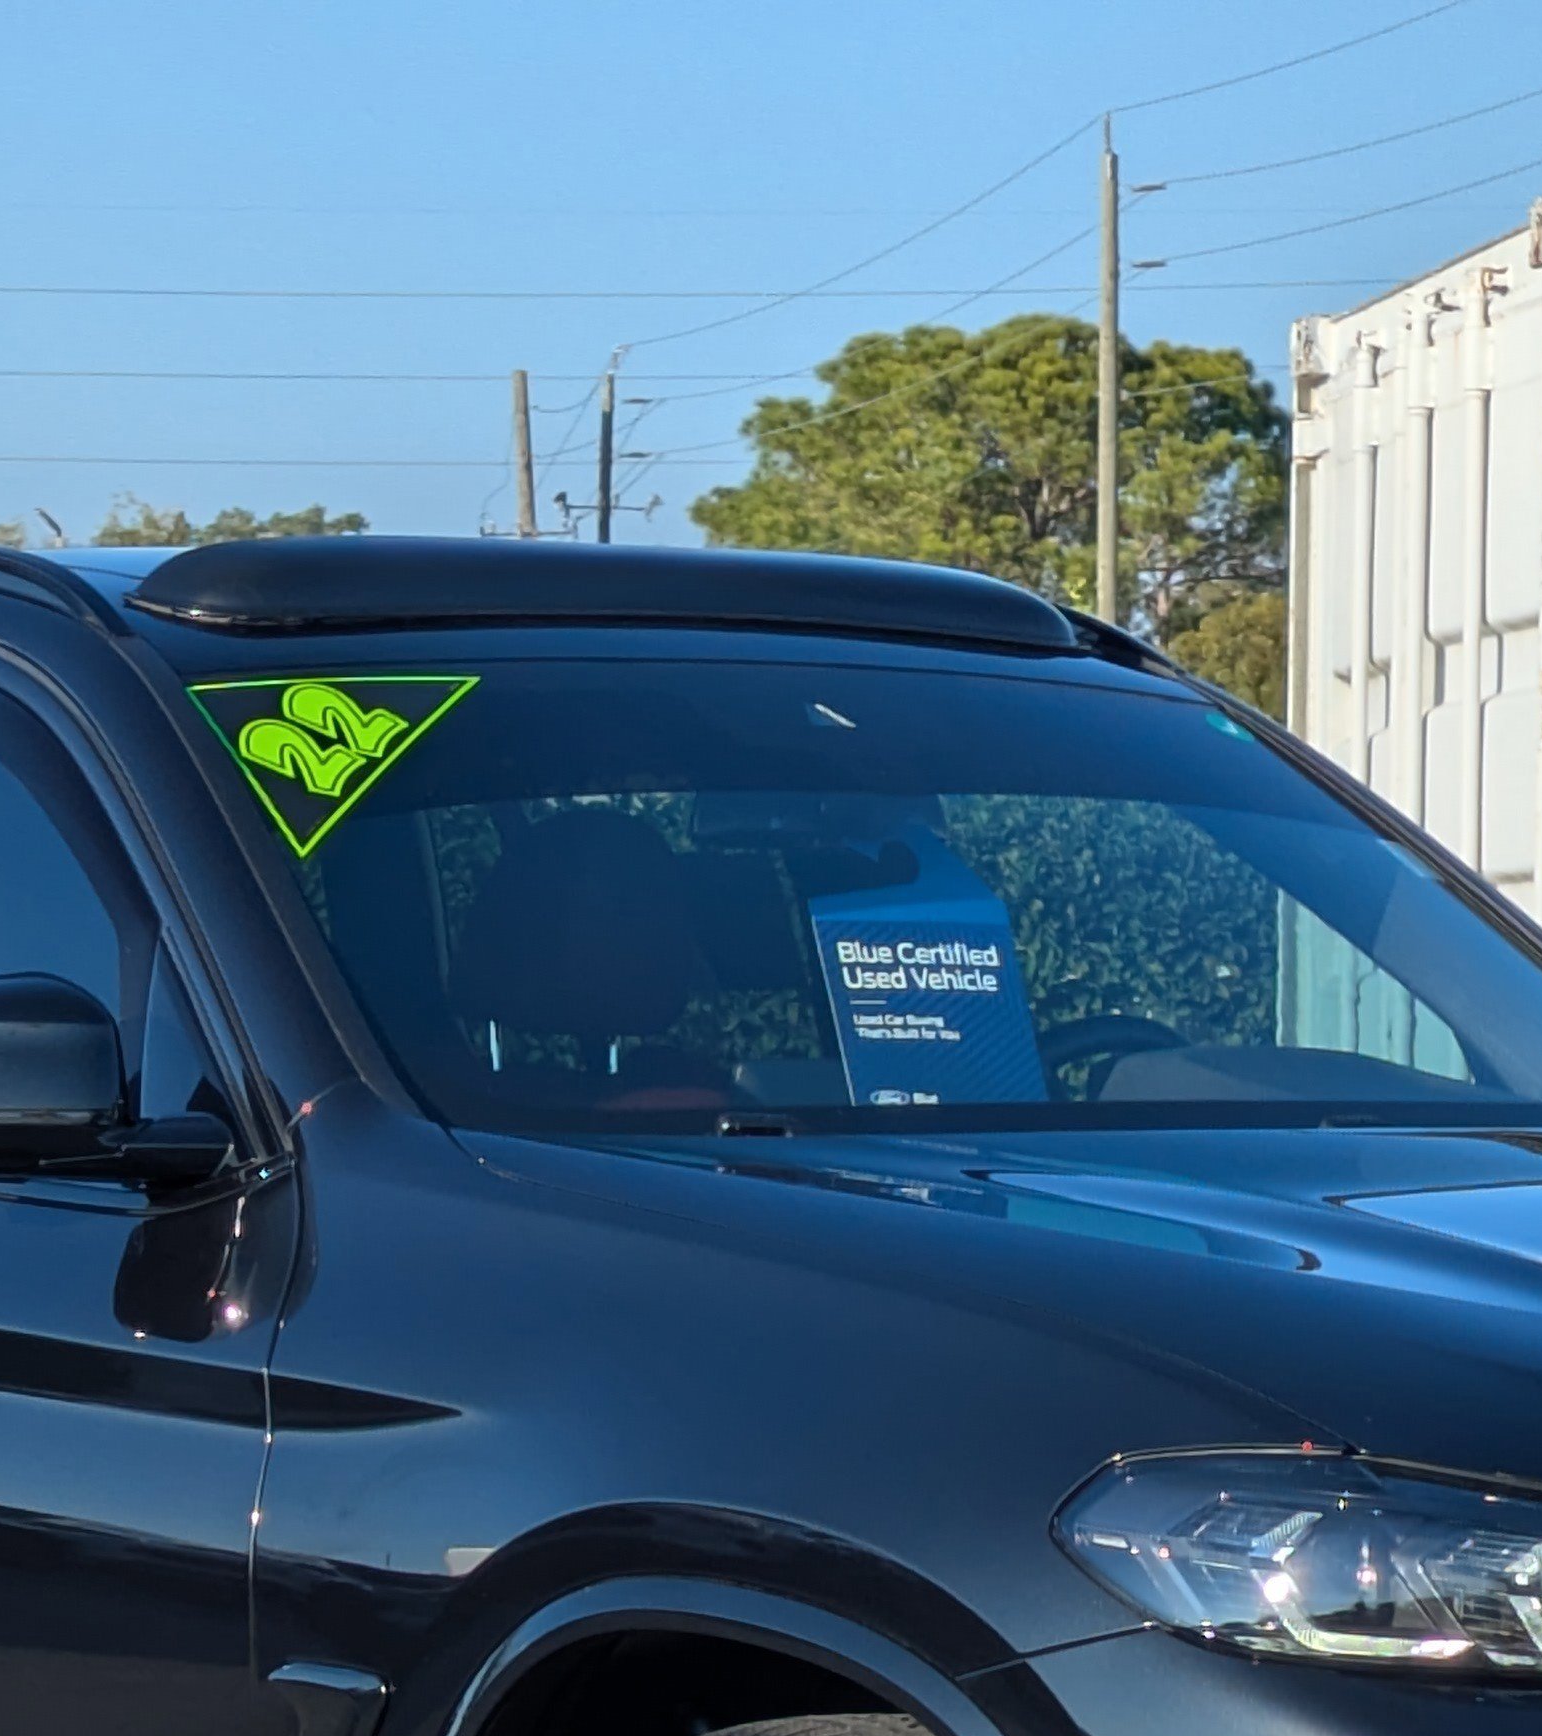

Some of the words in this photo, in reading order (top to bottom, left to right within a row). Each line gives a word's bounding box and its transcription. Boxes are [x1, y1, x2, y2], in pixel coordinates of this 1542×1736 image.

[238, 683, 409, 798] 22
[836, 941, 894, 964] Blue
[896, 942, 1001, 967] Certified
[841, 966, 907, 989] Used
[908, 967, 999, 992] Vehicle
